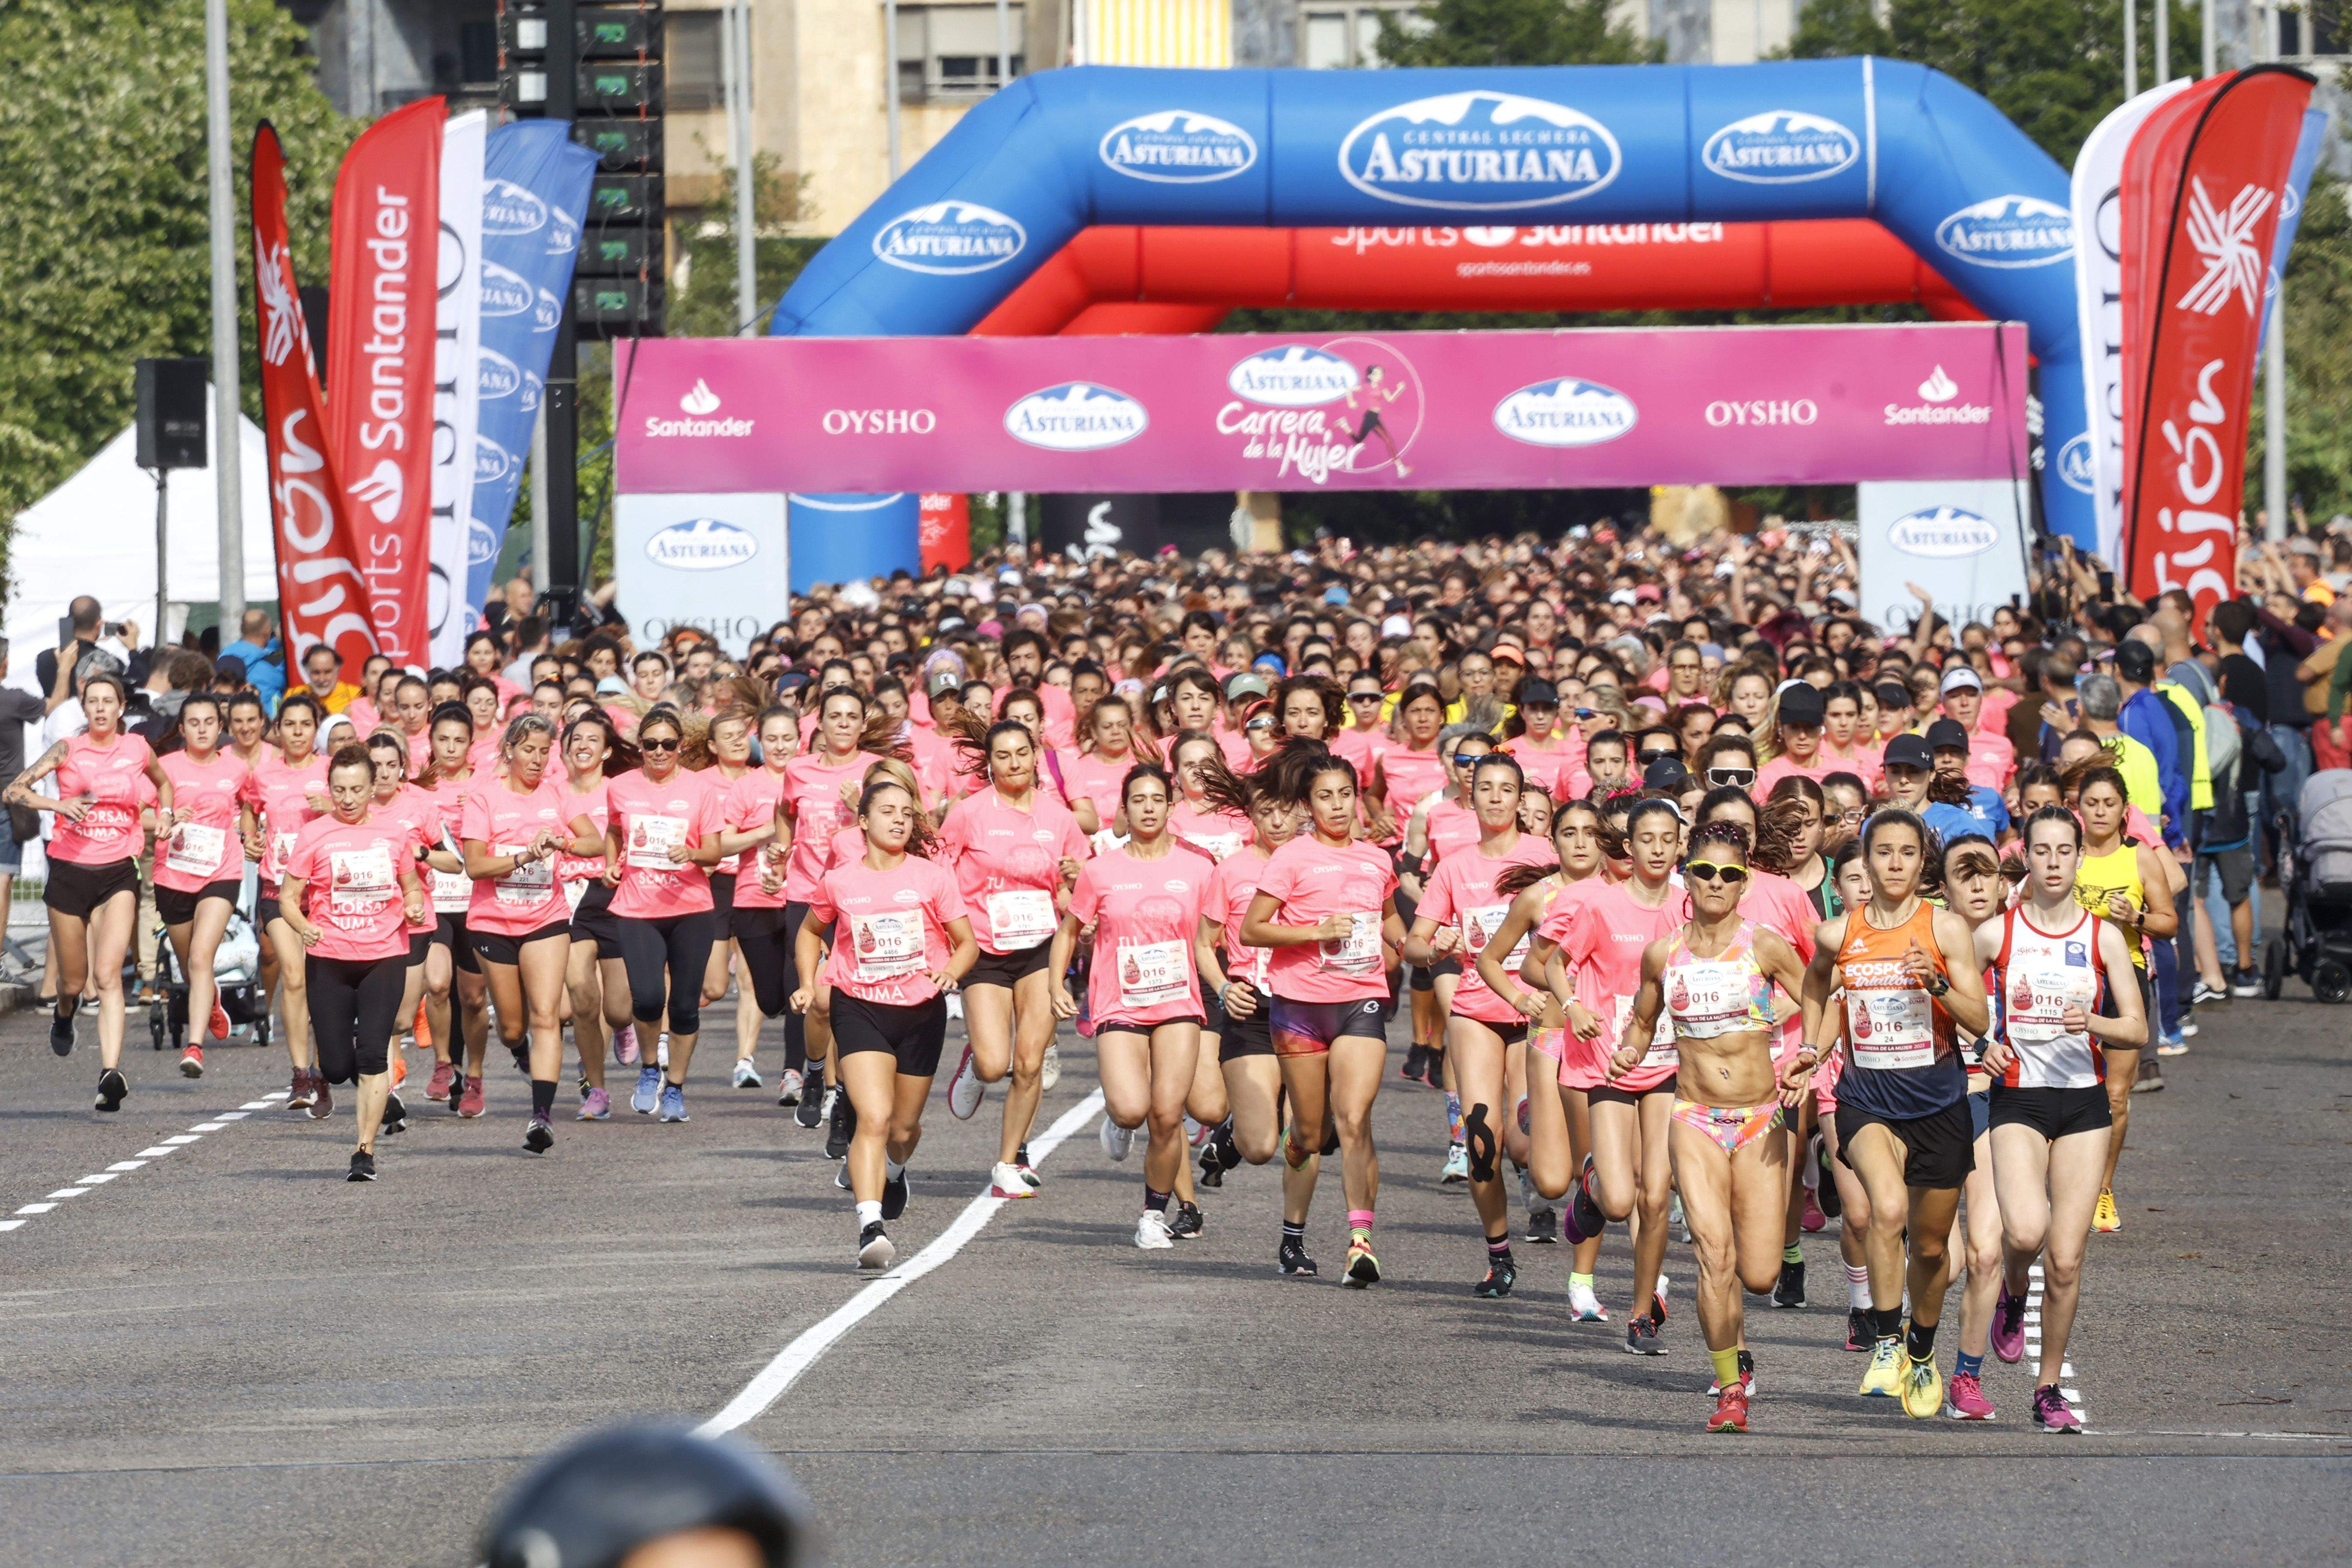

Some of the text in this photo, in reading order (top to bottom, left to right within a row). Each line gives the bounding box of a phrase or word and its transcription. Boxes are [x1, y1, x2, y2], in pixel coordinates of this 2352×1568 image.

[1403, 129, 1591, 144] CENTRAL LECHERA
[1111, 133, 1246, 167] ASTURIANA
[1714, 137, 1848, 169] ASTURIANA
[1360, 132, 1601, 183] ASTURIANA
[882, 227, 1015, 256] ASTURIANA
[359, 185, 409, 451] Santander
[1239, 368, 1349, 392] ASTURIANA
[1017, 407, 1136, 433] ASTURIANA
[1215, 400, 1327, 435] Carrera
[1504, 405, 1624, 428] ASTURIANA
[1704, 399, 1818, 428] OYSHO
[1884, 402, 1993, 426] Santander
[645, 415, 755, 438] Santander
[822, 408, 937, 435] OYSHO
[1243, 428, 1366, 486] de la Mujer
[1893, 526, 1990, 546] ASTURIANA
[653, 538, 749, 558] ASTURIANA
[363, 532, 411, 658] ports
[75, 825, 119, 839] SUMA
[989, 829, 1015, 837] OYSHO
[185, 842, 204, 853] 016
[649, 836, 667, 845] 016
[353, 871, 373, 880] 016
[1313, 864, 1343, 874] OYSHO
[986, 875, 1005, 890] TU
[1112, 882, 1142, 892] OYSHO
[842, 896, 872, 906] OYSHO
[2082, 897, 2101, 905] RUN
[331, 916, 376, 930] SUMA
[1013, 913, 1034, 922] 016
[878, 937, 902, 947] 016
[1343, 939, 1364, 949] 016
[1611, 934, 1644, 942] OYSHO
[2017, 946, 2039, 956] gijón
[1143, 967, 1166, 978] 016
[851, 984, 905, 1001] SUMA
[1692, 991, 1719, 1004] 016
[2035, 995, 2063, 1007] 016
[1874, 1021, 1903, 1032] 016
[2015, 1026, 2038, 1035] OYSHO
[1901, 1053, 1928, 1062] Santander
